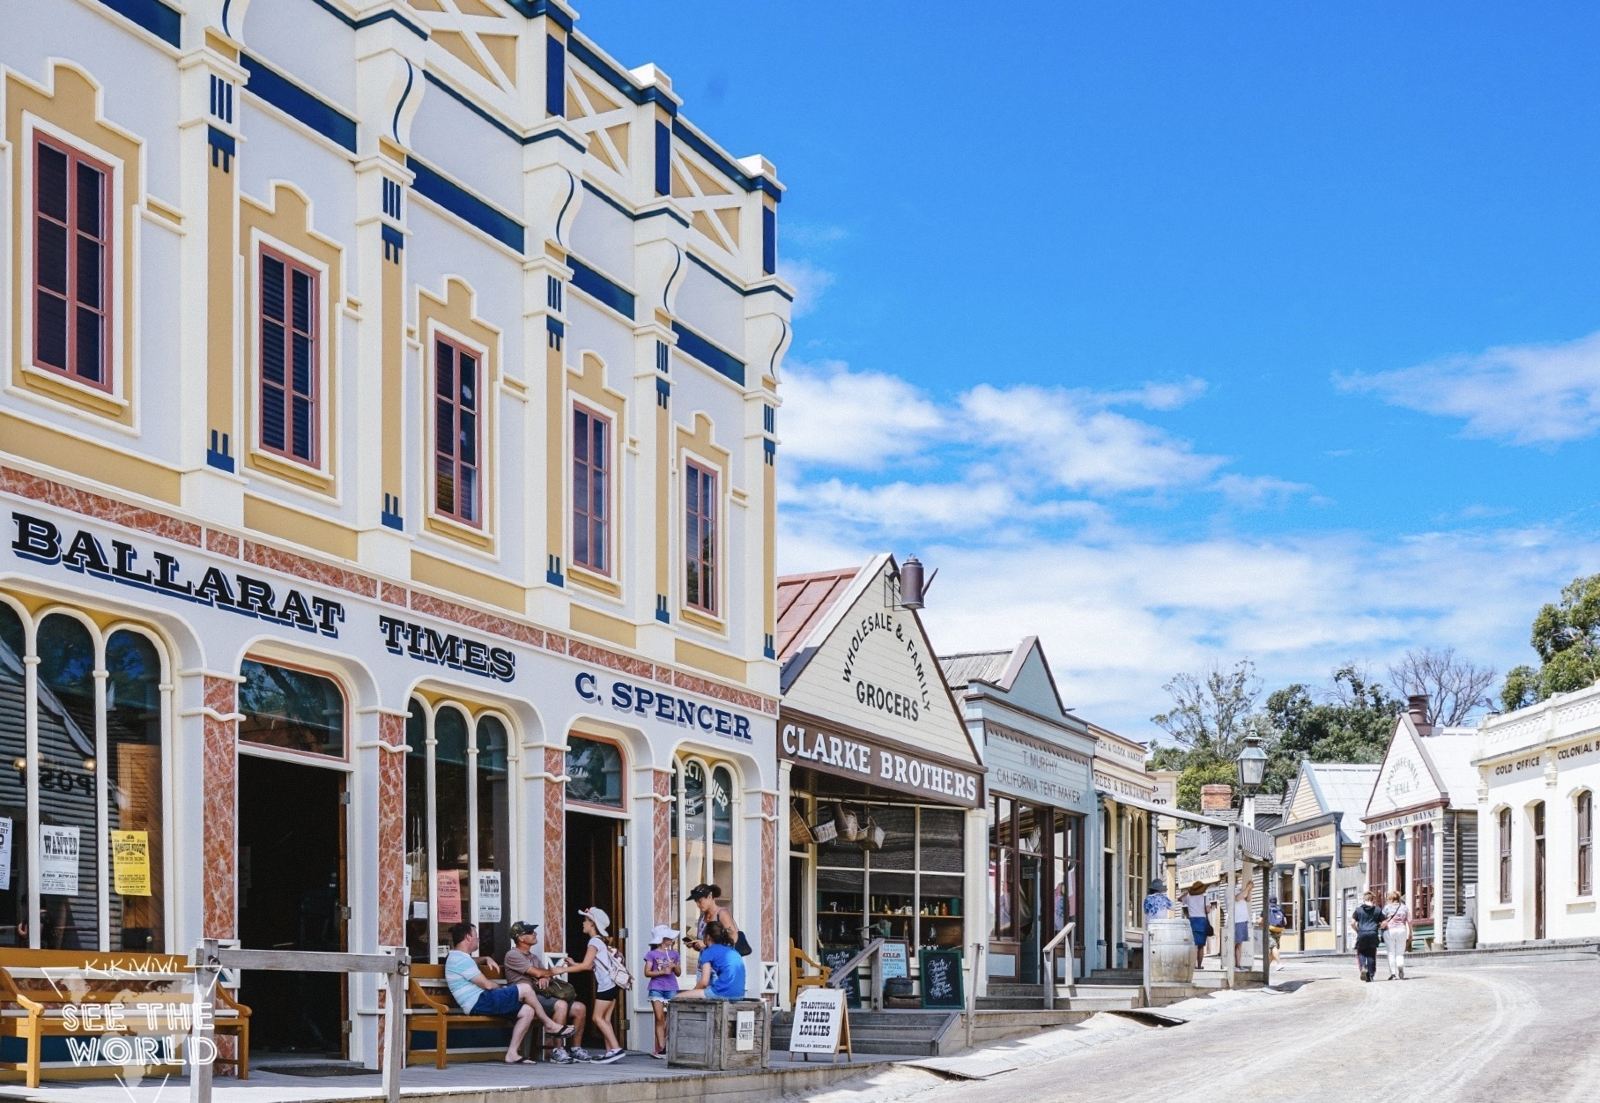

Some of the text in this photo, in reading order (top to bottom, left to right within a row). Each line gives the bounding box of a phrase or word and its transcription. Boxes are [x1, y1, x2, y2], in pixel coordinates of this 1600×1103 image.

[11, 512, 516, 682] BALLARAT TIMES
[842, 612, 930, 711] WHOLESALE & FAMILY
[575, 672, 753, 744] C. SPENCER
[856, 680, 919, 722] GROCERS
[782, 723, 977, 801] CLARKE BROTHERS
[1557, 743, 1593, 760] COLONIAL
[1030, 752, 1058, 774] MURPHY
[1516, 756, 1540, 770] OFFICE
[996, 767, 1081, 804] CALIFORNIA TENT MAKER
[43, 835, 78, 855] WANTED
[801, 1001, 836, 1010] TRADITIONAL
[803, 1011, 830, 1023] BOILED
[799, 1024, 831, 1037] LOLLIES
